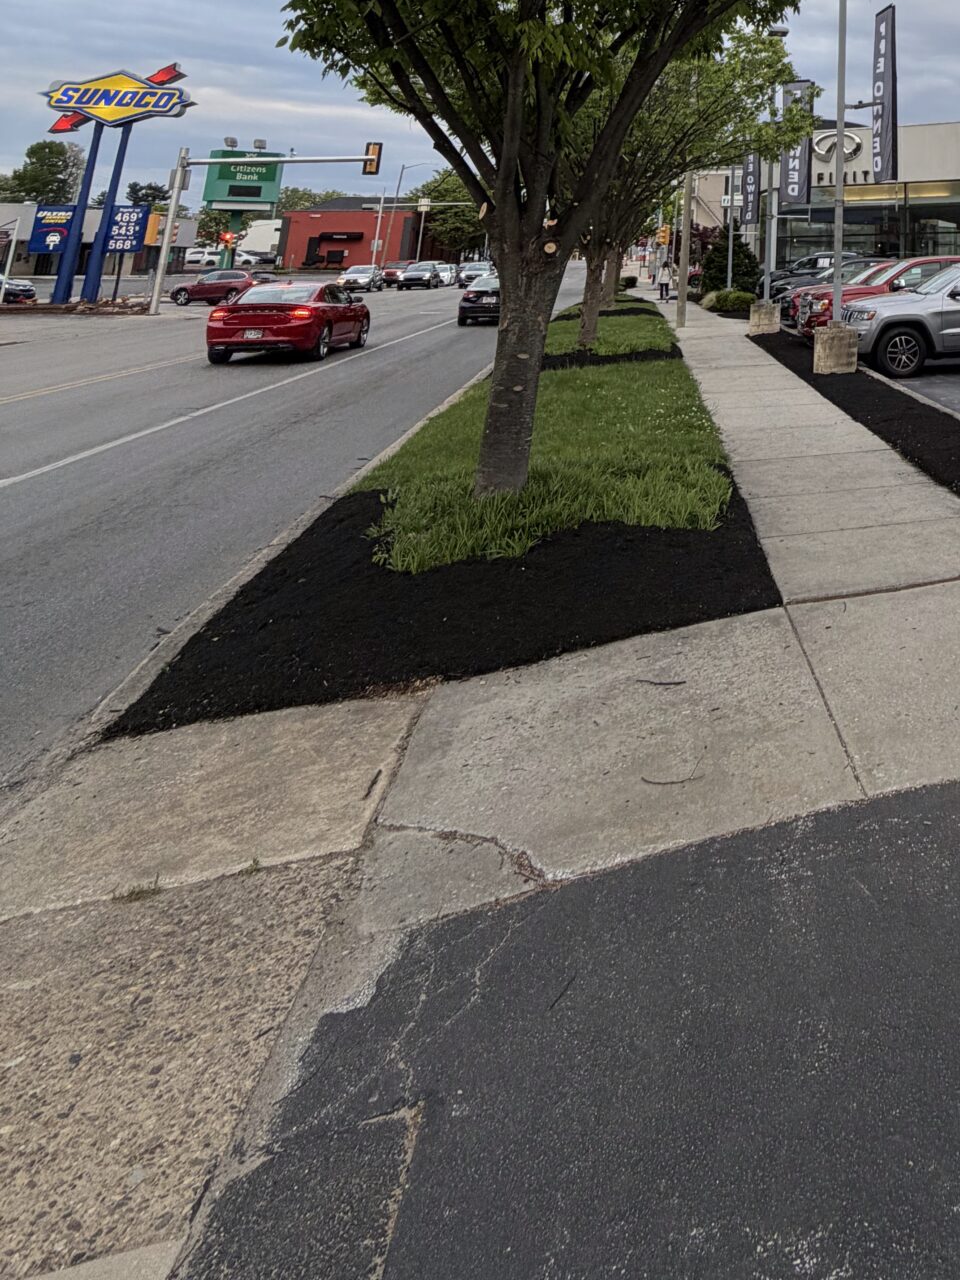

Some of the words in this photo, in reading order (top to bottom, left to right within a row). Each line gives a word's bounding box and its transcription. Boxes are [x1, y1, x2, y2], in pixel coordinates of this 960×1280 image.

[54, 87, 177, 109] SUNOCO
[230, 164, 267, 173] Citizens
[236, 172, 259, 180] Bank
[114, 212, 137, 222] 469
[111, 225, 134, 235] 543
[108, 240, 131, 249] 568
